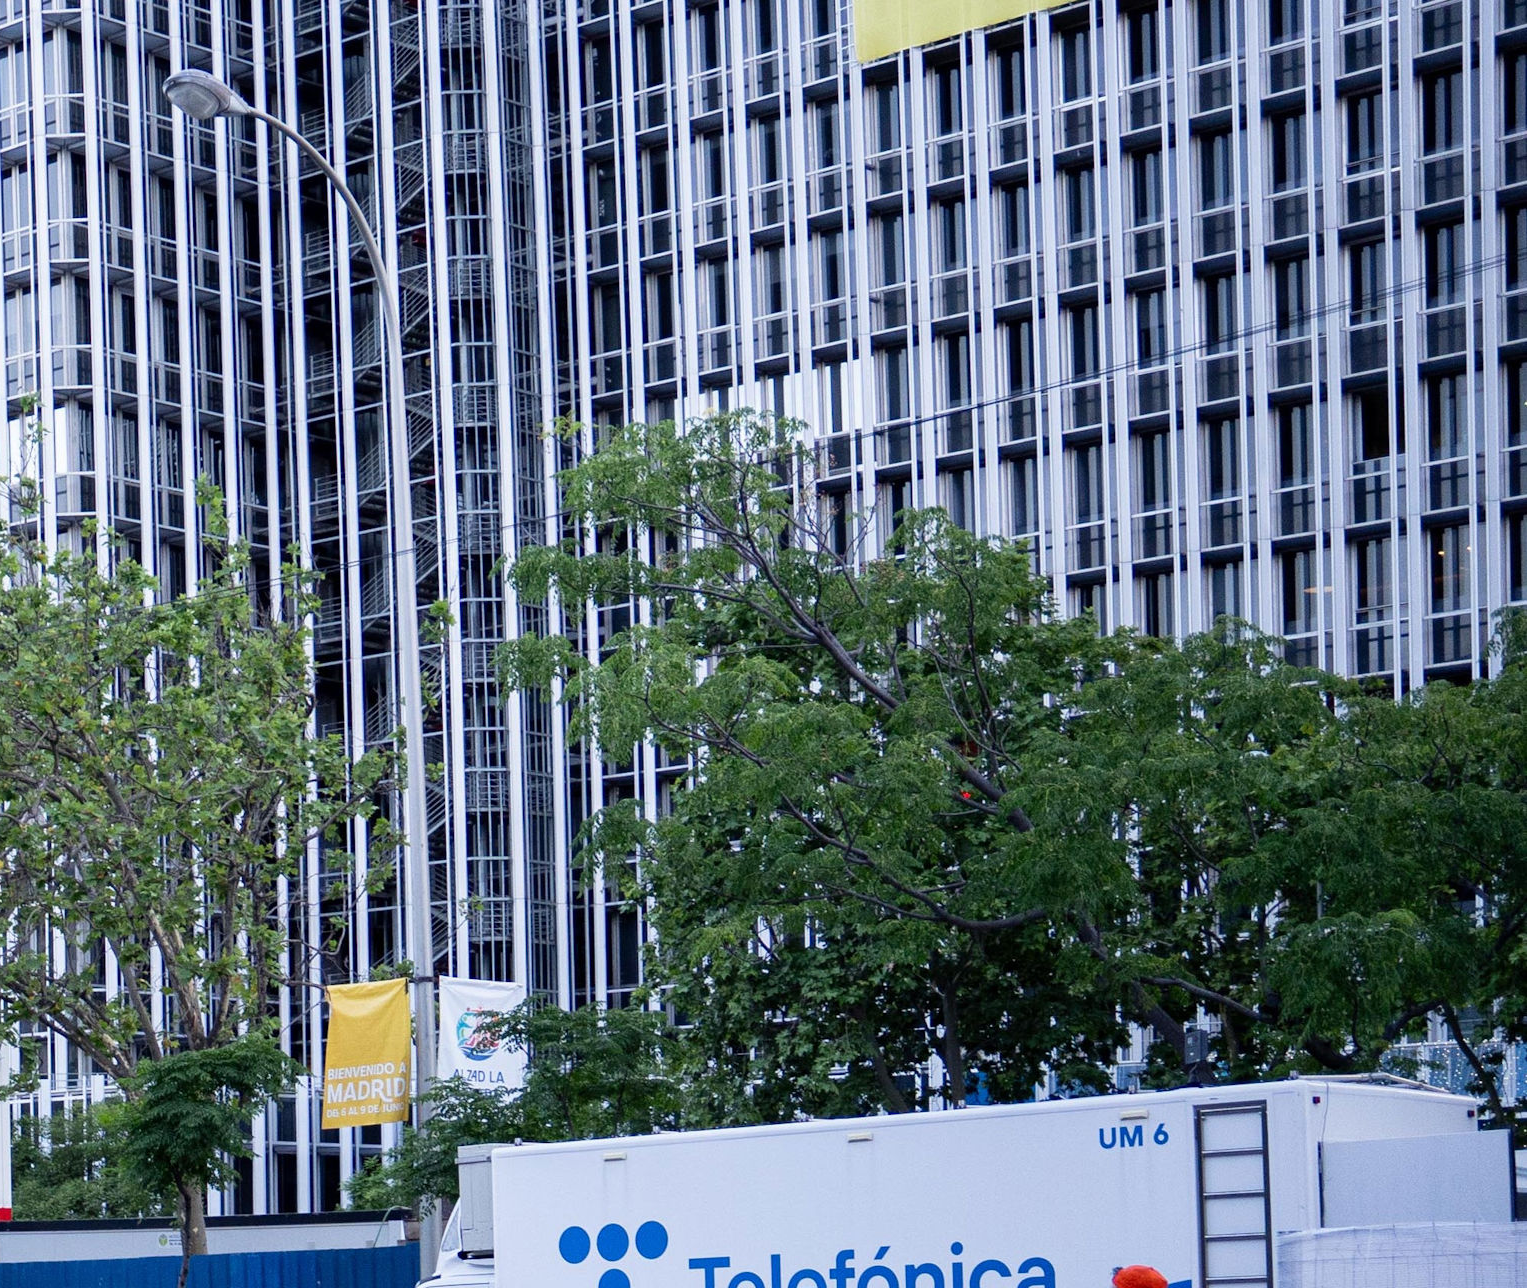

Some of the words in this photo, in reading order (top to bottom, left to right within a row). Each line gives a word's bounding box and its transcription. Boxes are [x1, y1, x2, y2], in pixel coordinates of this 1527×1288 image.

[328, 1062, 395, 1080] BIENVENIDO
[399, 1062, 406, 1073] A
[489, 1071, 505, 1083] LA
[327, 1077, 406, 1103] MADRID
[348, 1107, 358, 1115] AL
[367, 1104, 380, 1113] DE
[1099, 1125, 1143, 1149] UM
[1153, 1123, 1169, 1145] 6
